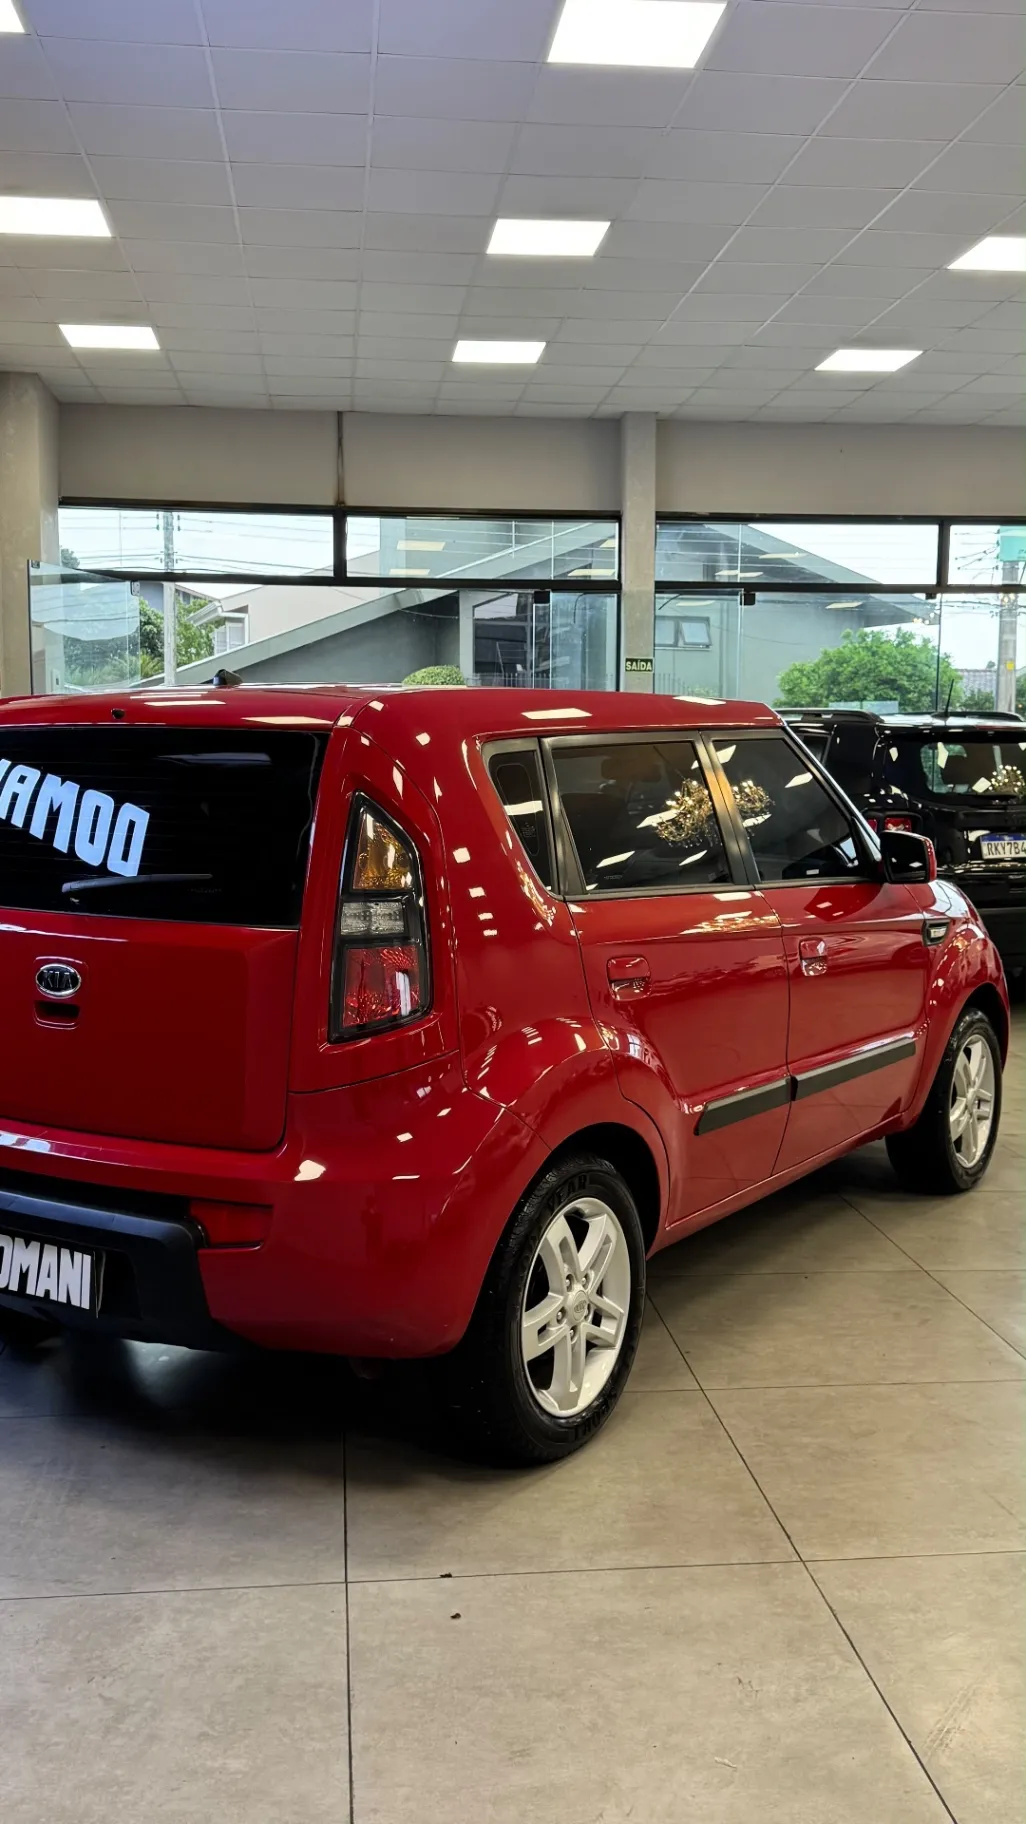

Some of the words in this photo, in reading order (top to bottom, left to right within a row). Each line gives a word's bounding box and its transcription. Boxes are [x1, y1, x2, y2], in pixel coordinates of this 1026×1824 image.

[626, 660, 652, 671] SAÍDA
[987, 841, 1026, 857] RKY7B4
[42, 970, 73, 989] KIA
